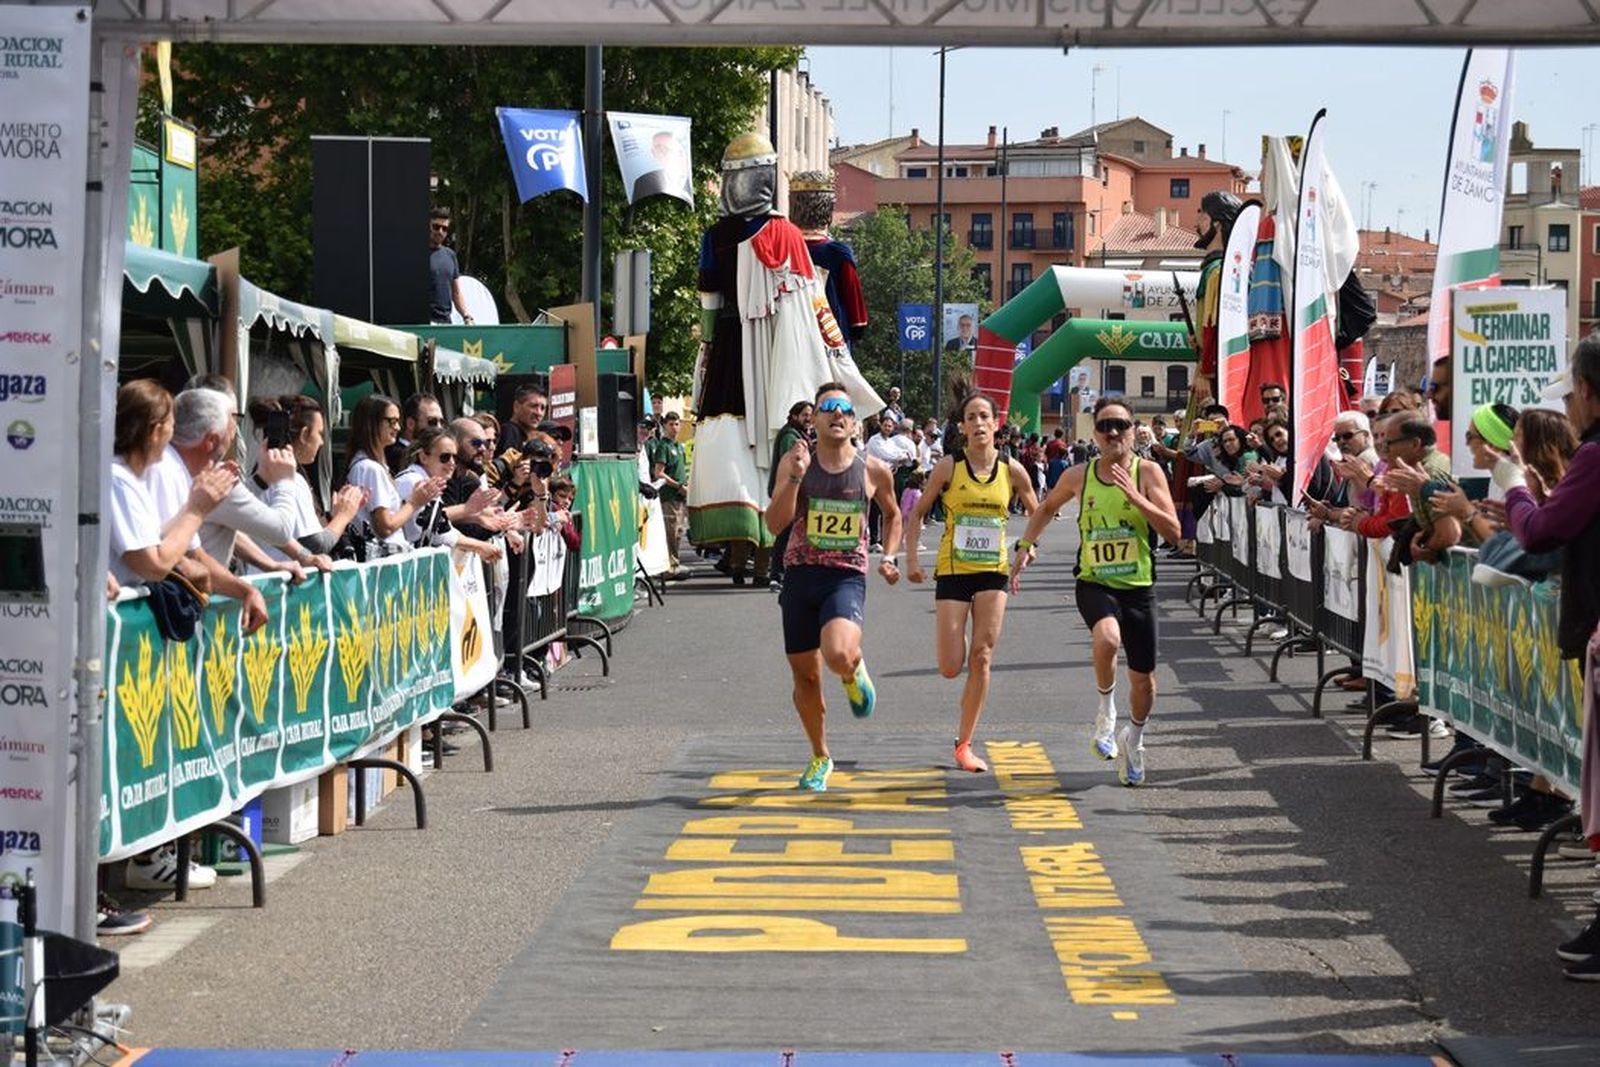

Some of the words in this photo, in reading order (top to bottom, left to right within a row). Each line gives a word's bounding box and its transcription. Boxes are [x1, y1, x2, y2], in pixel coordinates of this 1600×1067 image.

[4, 53, 63, 68] RURAL
[0, 123, 62, 138] MIENTO
[1147, 296, 1163, 307] DE
[905, 316, 927, 324] VOTA
[1471, 313, 1551, 341] TERMINAR
[1139, 331, 1187, 349] CAJA
[1463, 345, 1483, 373] LA
[1486, 345, 1557, 373] CARRERA
[1472, 377, 1492, 405] EN
[814, 514, 853, 535] 124
[1091, 541, 1130, 563] 107
[1043, 915, 1178, 1005] REFORMA
